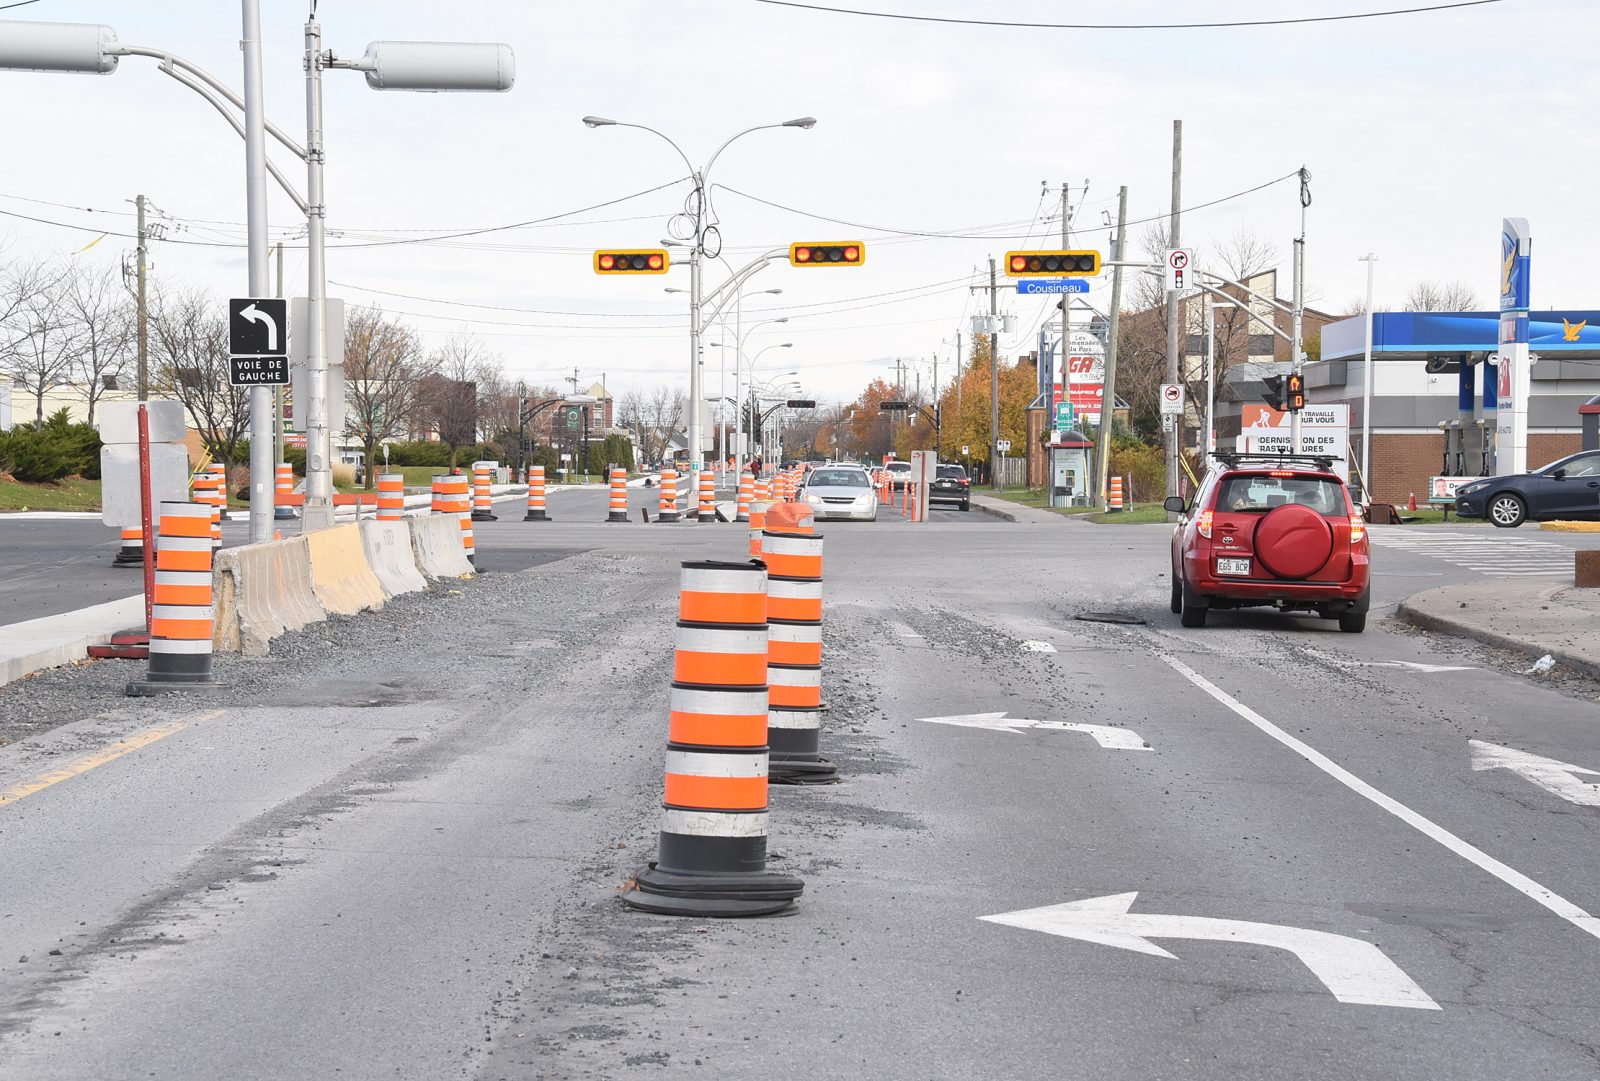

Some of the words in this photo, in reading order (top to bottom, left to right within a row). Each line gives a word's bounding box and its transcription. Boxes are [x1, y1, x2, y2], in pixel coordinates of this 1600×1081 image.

[1027, 283, 1081, 294] Cousineau
[236, 361, 262, 370] VOIE
[268, 360, 283, 369] DE
[1058, 356, 1094, 374] GA
[239, 371, 282, 381] GAUCHE
[1317, 436, 1335, 444] DES
